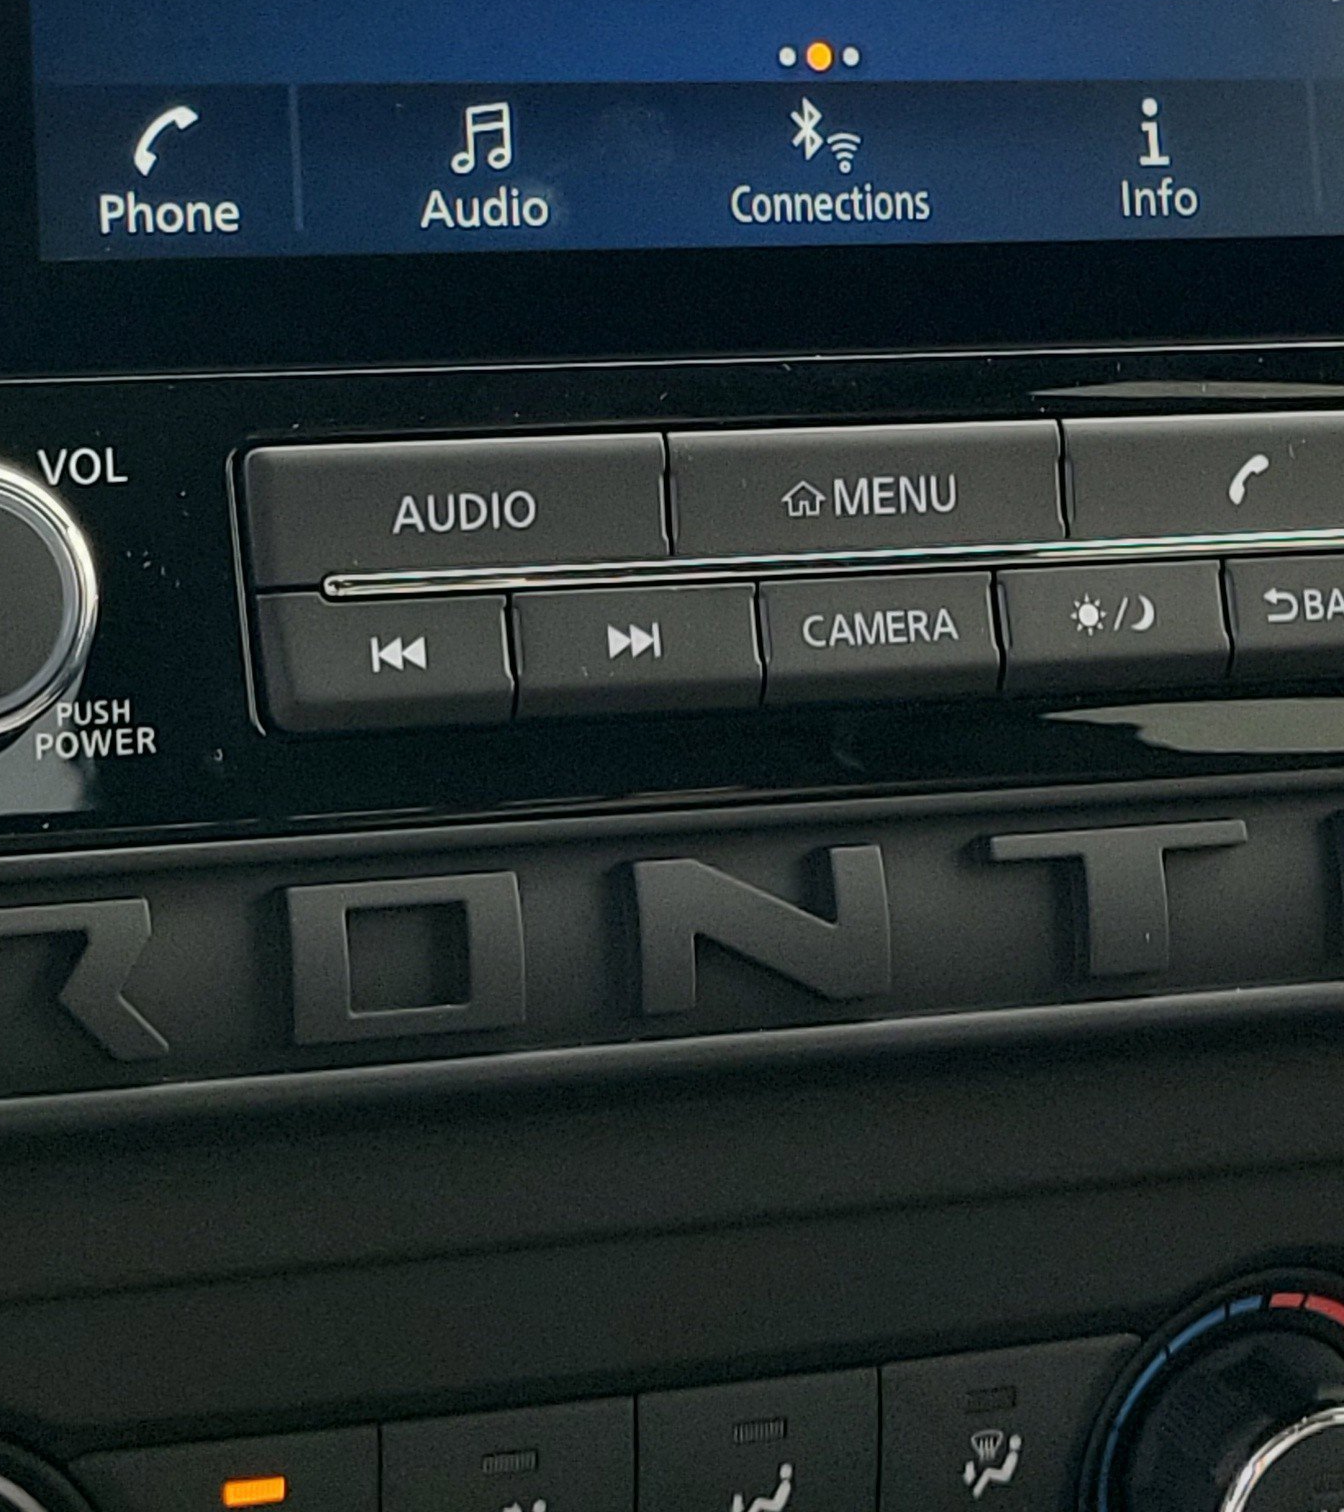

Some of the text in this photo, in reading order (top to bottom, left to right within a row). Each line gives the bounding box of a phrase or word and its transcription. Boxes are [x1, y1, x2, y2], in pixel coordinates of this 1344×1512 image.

[100, 191, 240, 234] Phone
[420, 185, 549, 228] Audio
[731, 183, 930, 223] Connections
[1121, 177, 1198, 217] Info
[37, 446, 129, 486] VOL
[392, 490, 536, 534] AUDIO
[833, 474, 956, 516] MENU
[802, 608, 959, 647] CAMERA
[56, 700, 132, 727] PUSH
[35, 726, 157, 762] POWER
